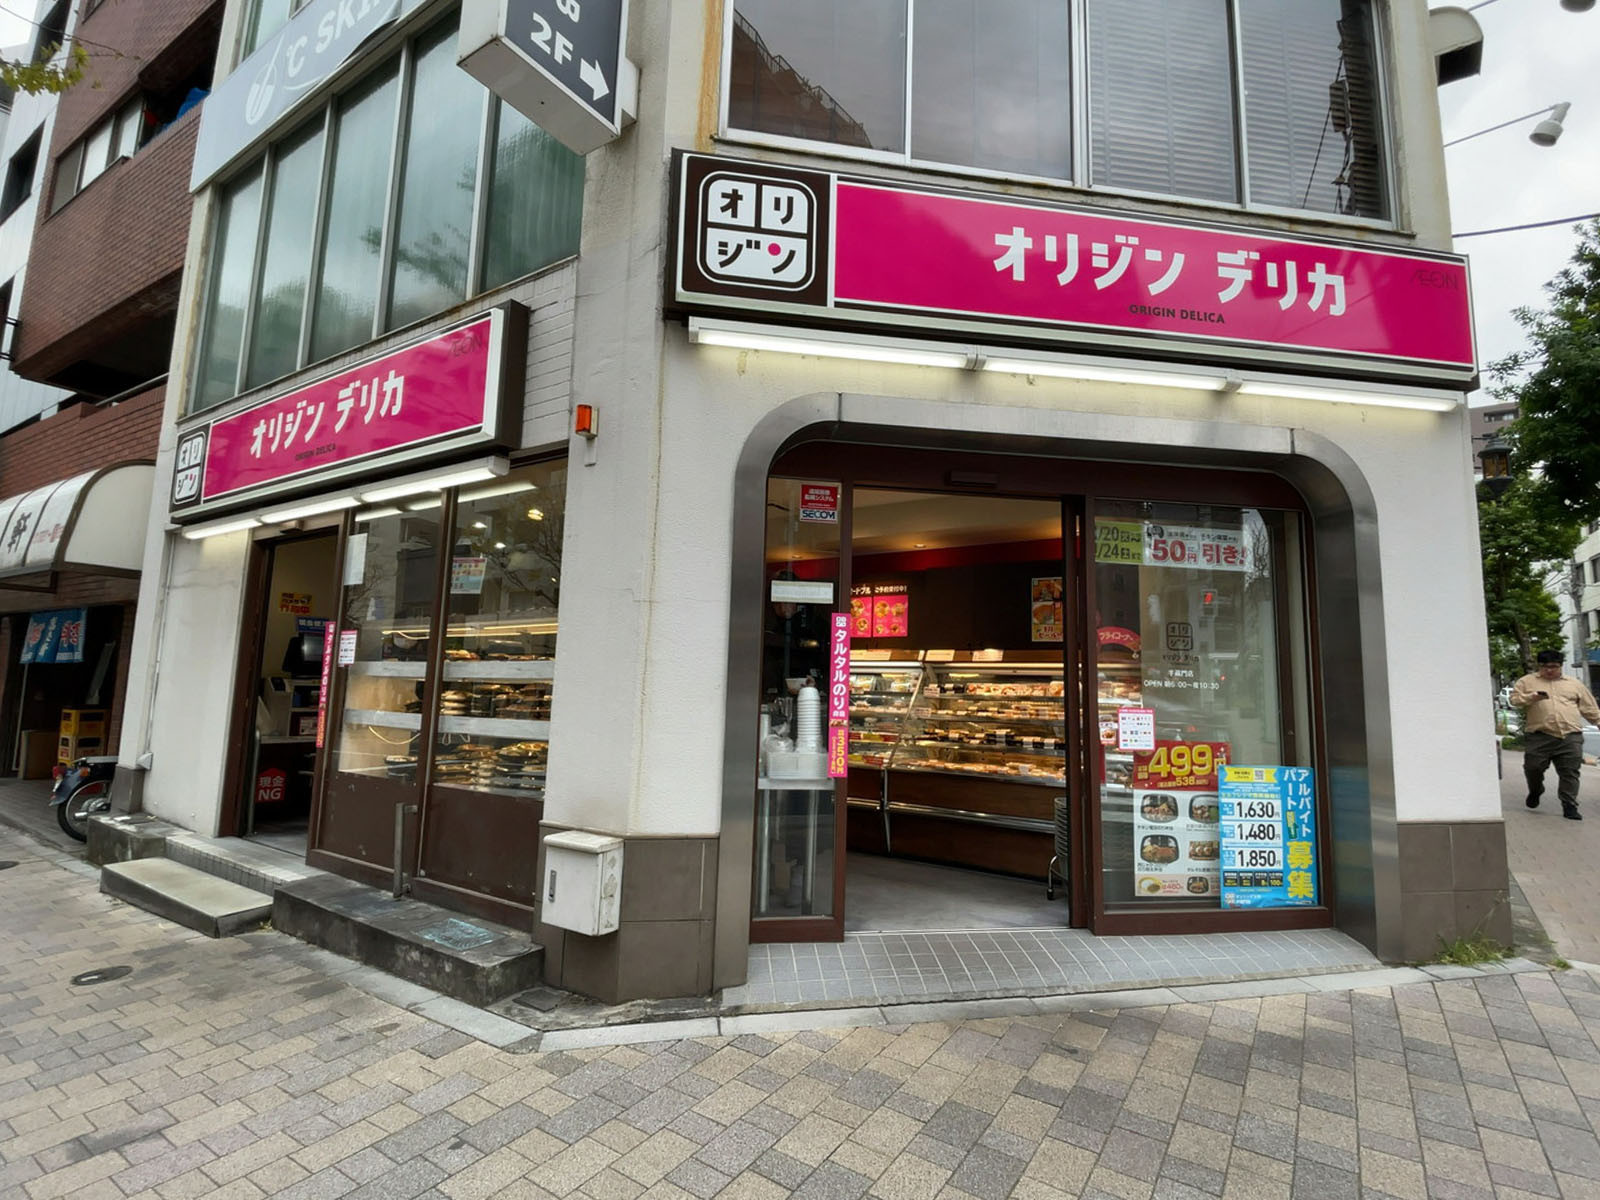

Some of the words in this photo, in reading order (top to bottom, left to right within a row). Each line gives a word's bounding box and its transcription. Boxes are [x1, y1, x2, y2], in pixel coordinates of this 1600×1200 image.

[530, 12, 573, 64] 2F
[720, 188, 794, 225] オリ
[718, 239, 796, 274] ジン
[993, 226, 1185, 296] オリジン
[1217, 250, 1346, 316] デリカ
[1129, 304, 1176, 318] ORIGIN
[1180, 310, 1225, 324] DELICA
[250, 400, 325, 459] オリジン
[335, 370, 405, 434] デリカ
[802, 509, 836, 520] SECOM
[1144, 680, 1163, 688] OPEN
[258, 788, 282, 801] NG
[259, 775, 284, 788] 現金
[1283, 768, 1297, 810] パート
[1298, 768, 1312, 838] アルバイト
[1286, 841, 1315, 899] 募集
